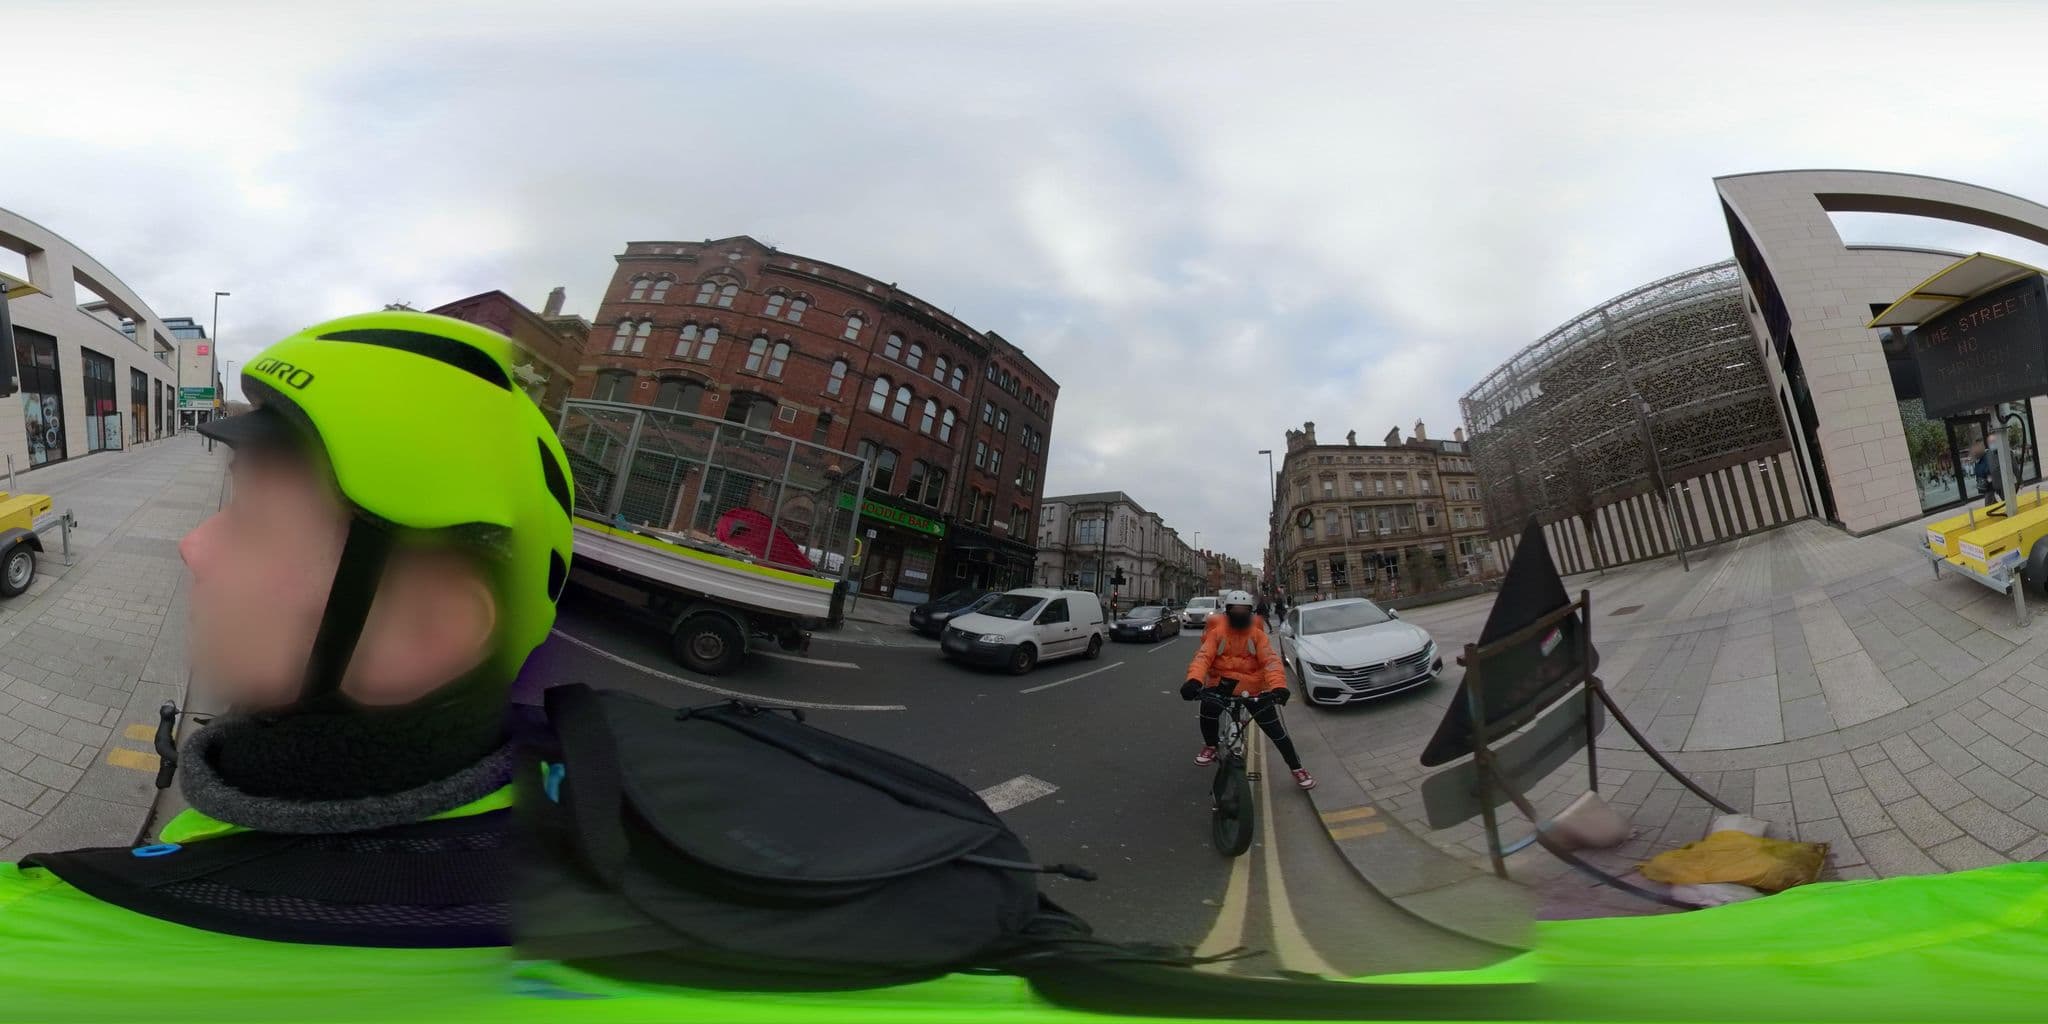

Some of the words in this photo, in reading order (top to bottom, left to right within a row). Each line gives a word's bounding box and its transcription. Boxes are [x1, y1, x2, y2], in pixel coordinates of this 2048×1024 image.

[1958, 293, 2032, 332] STREET
[255, 358, 314, 390] GIRO
[1504, 382, 1544, 415] PARK
